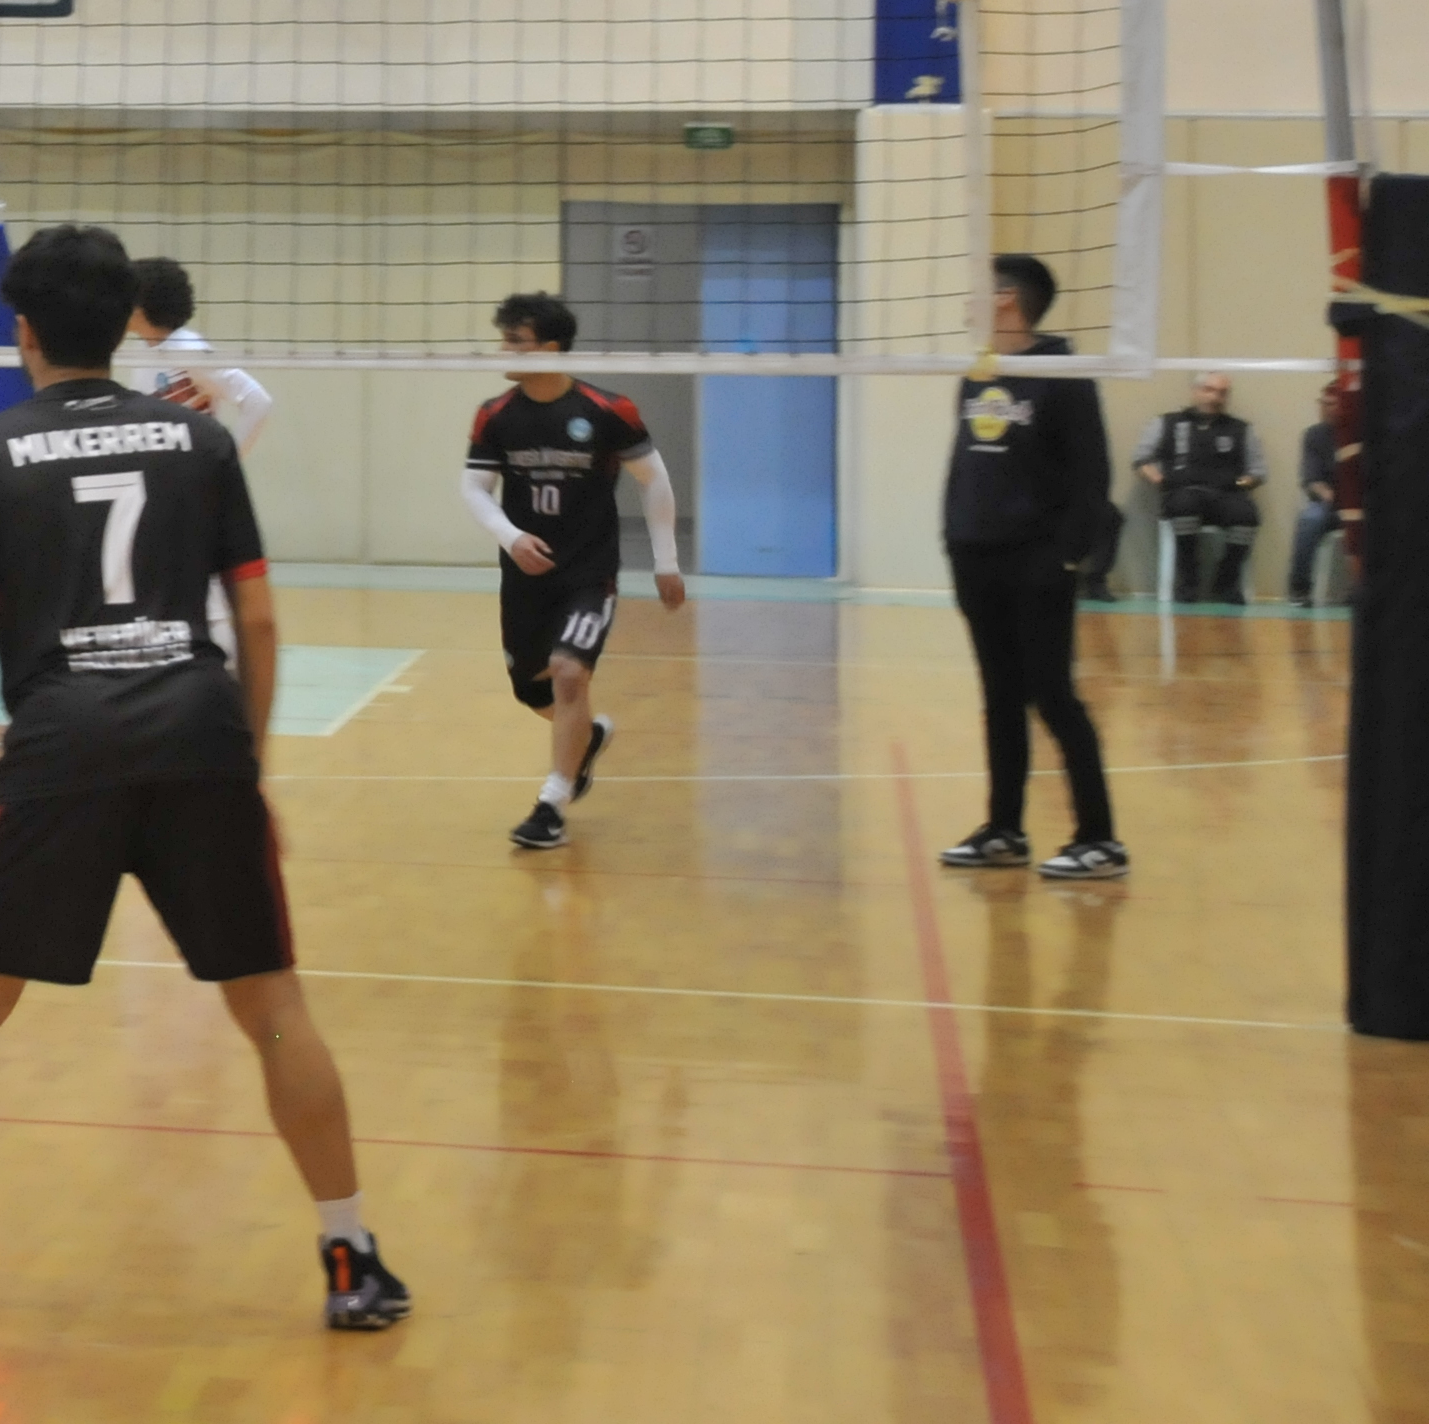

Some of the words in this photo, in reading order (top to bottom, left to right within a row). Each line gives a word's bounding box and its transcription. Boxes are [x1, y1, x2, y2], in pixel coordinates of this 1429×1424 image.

[530, 484, 561, 516] 10
[70, 470, 148, 605] 7
[560, 610, 601, 650] 10
